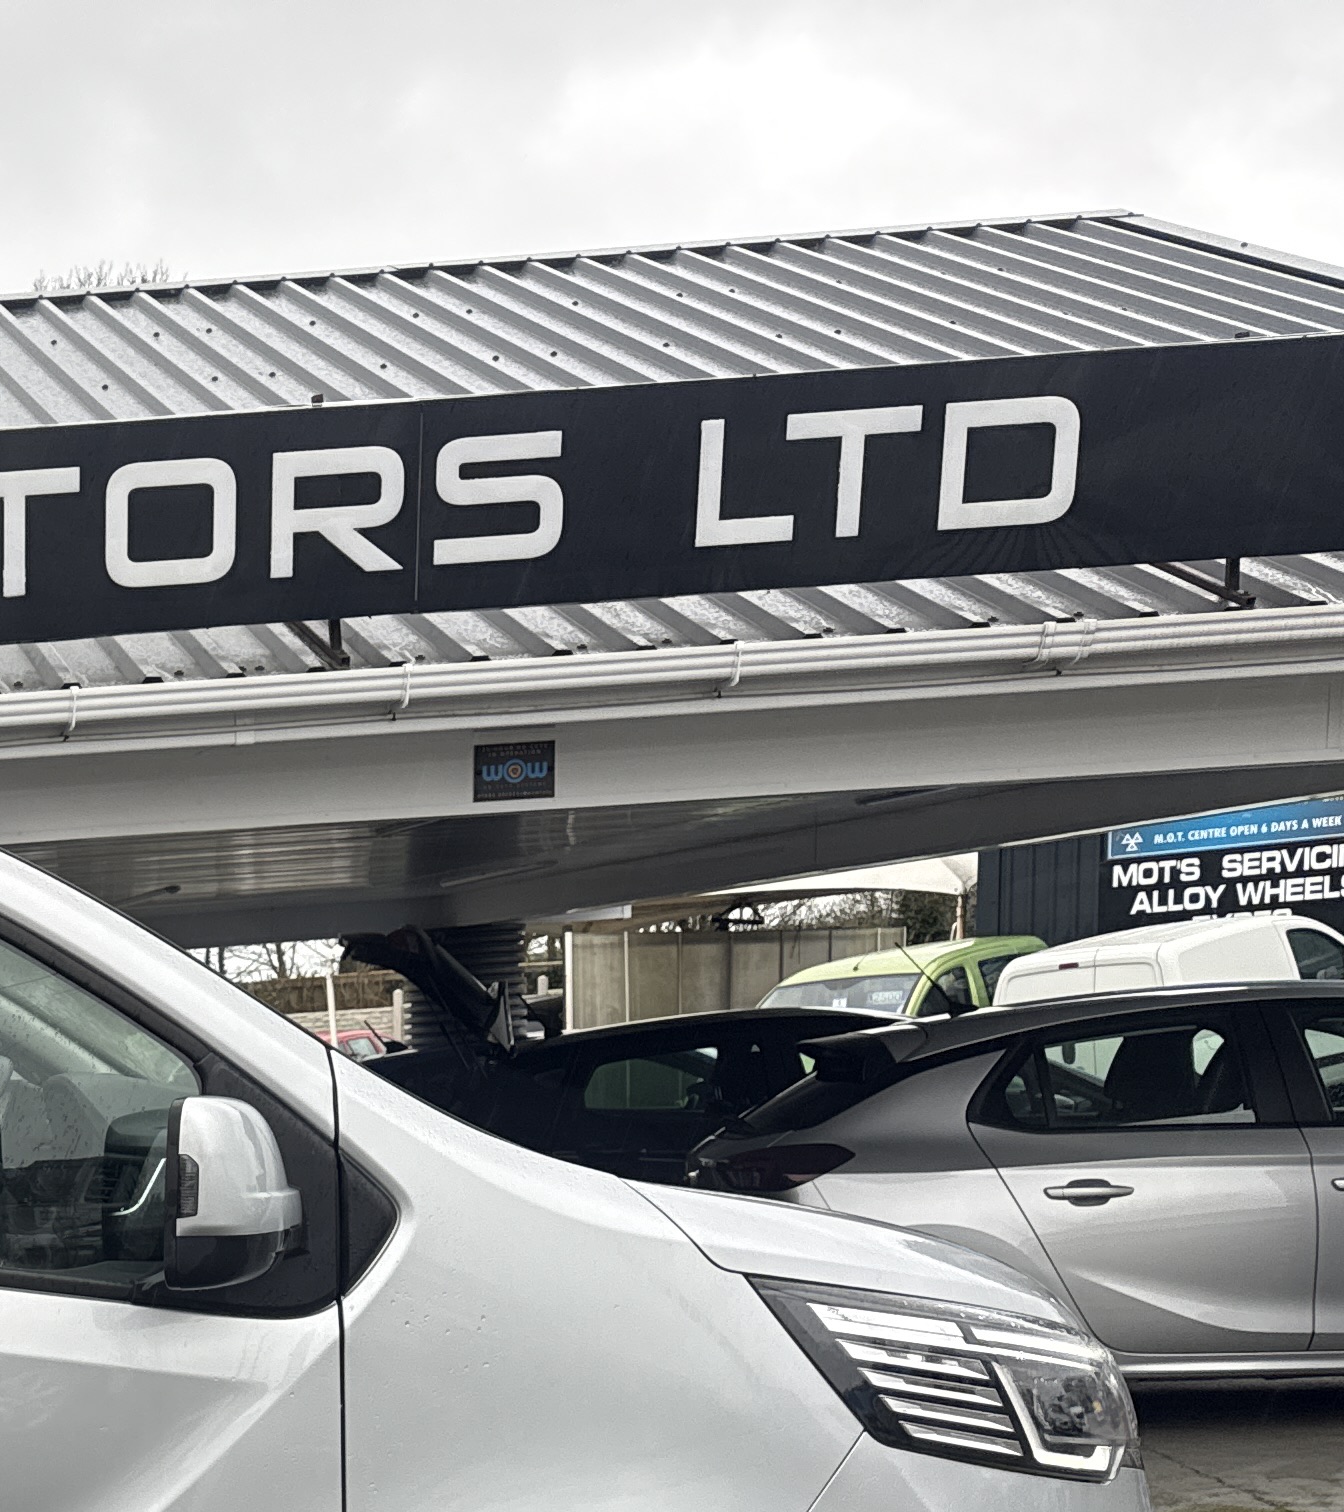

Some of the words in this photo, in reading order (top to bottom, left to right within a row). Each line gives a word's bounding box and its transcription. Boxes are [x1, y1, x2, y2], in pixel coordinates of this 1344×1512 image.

[694, 396, 1082, 549] LTD
[1153, 831, 1186, 845] M.O.T.
[1188, 827, 1228, 841] CENTRE
[1230, 823, 1259, 837] OPEN
[1261, 822, 1269, 835] 6
[1271, 819, 1299, 833] DAYS
[1301, 818, 1310, 830] A
[1312, 815, 1343, 829] WEEK
[1112, 857, 1201, 888] MOT'S
[1221, 843, 1344, 879] SERVICI
[1129, 884, 1227, 916] ALLOY
[1236, 874, 1344, 906] WHEEL
